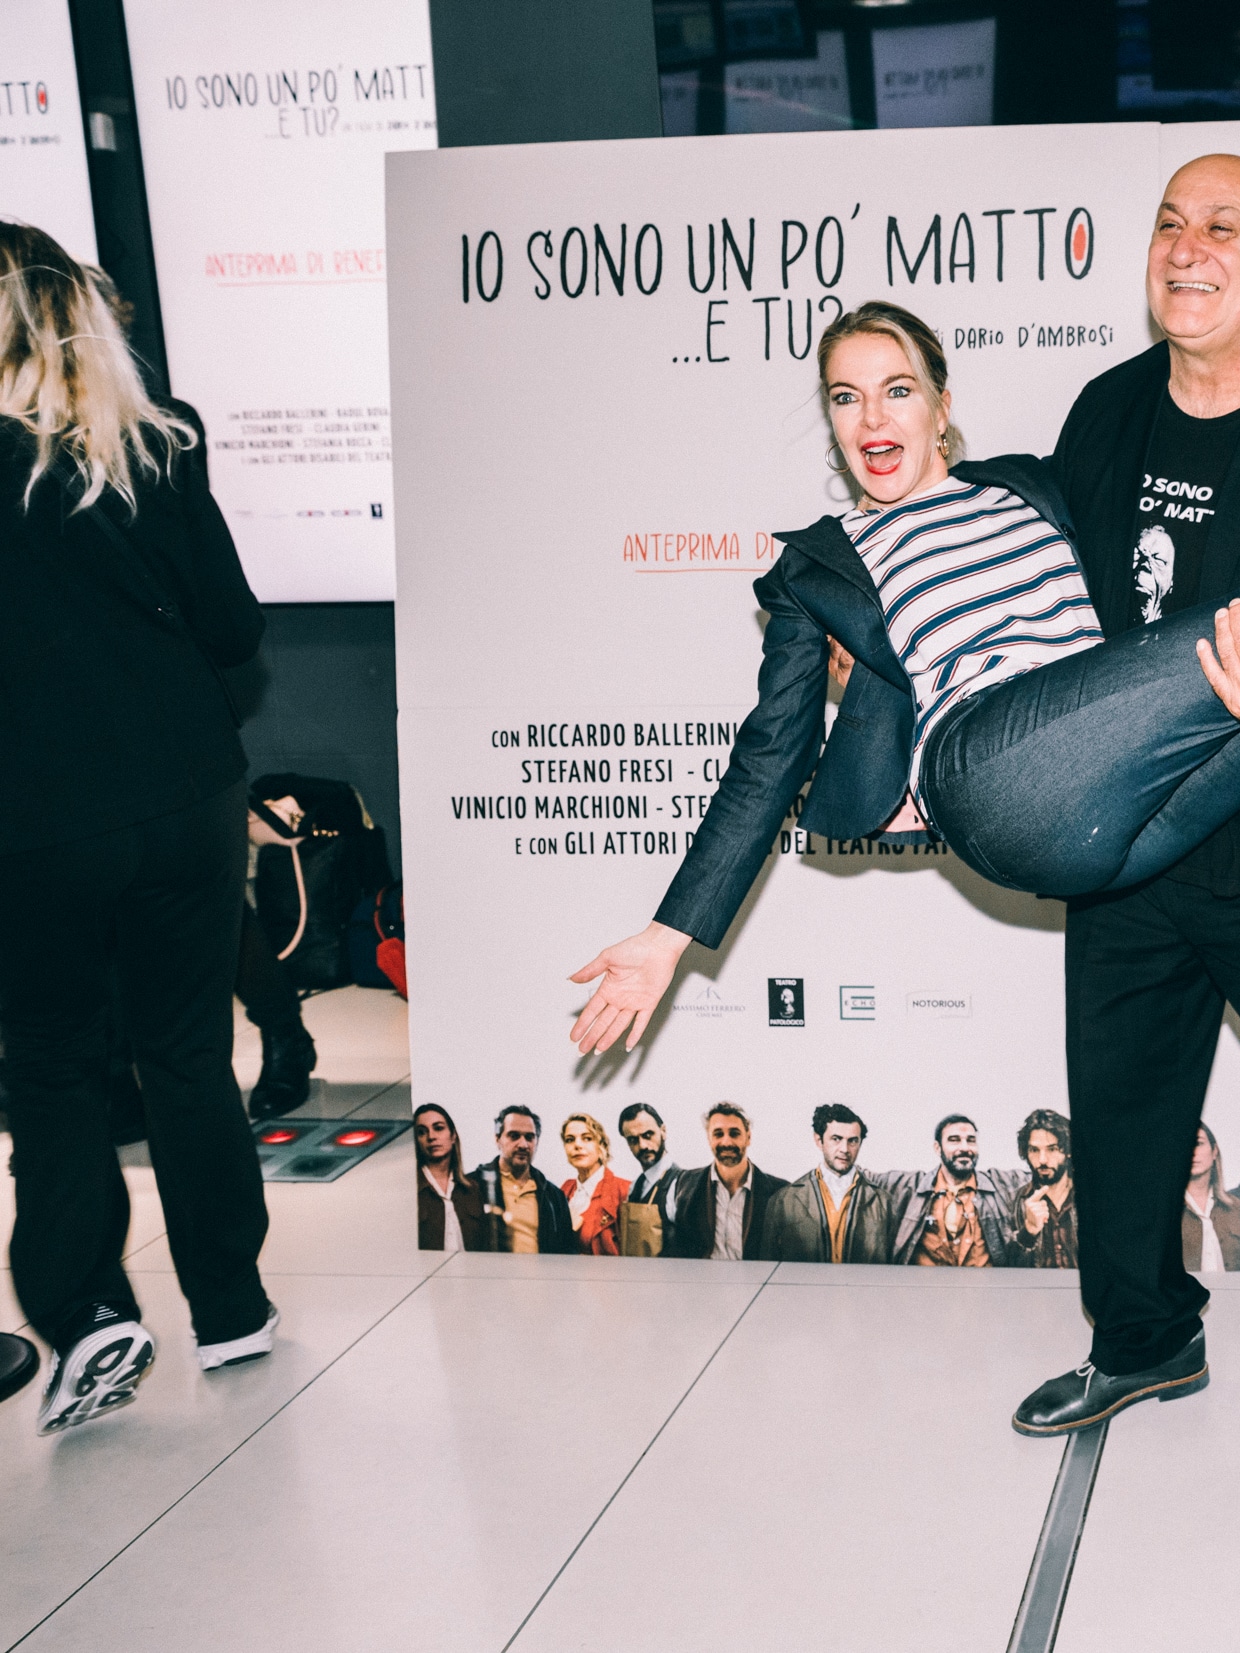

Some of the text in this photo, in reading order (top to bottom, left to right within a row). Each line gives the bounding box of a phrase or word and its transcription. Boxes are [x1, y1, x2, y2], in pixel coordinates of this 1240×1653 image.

[0, 81, 49, 115] TTO
[165, 75, 188, 111] IO
[196, 73, 259, 109] SONO
[266, 71, 299, 105] UN
[308, 64, 343, 104] PO'
[300, 106, 340, 138] TU?
[461, 202, 1095, 304] IO SONO UN PO' MATTO
[1152, 477, 1214, 501] SONO
[622, 531, 775, 563] ANTEPRIMA DI
[491, 722, 737, 749] CON RICCARDO BALLERINI
[521, 759, 611, 784] STEFANO
[618, 758, 673, 783] FRESI
[450, 795, 527, 820] VINICIO
[534, 794, 648, 820] MARCHIONI
[671, 795, 713, 818] STE
[514, 837, 522, 856] E
[528, 837, 558, 856] CON
[564, 830, 595, 856] GLI
[602, 830, 677, 855] ATTORI
[780, 829, 816, 856] DEL
[911, 999, 966, 1009] NOTORIOUS
